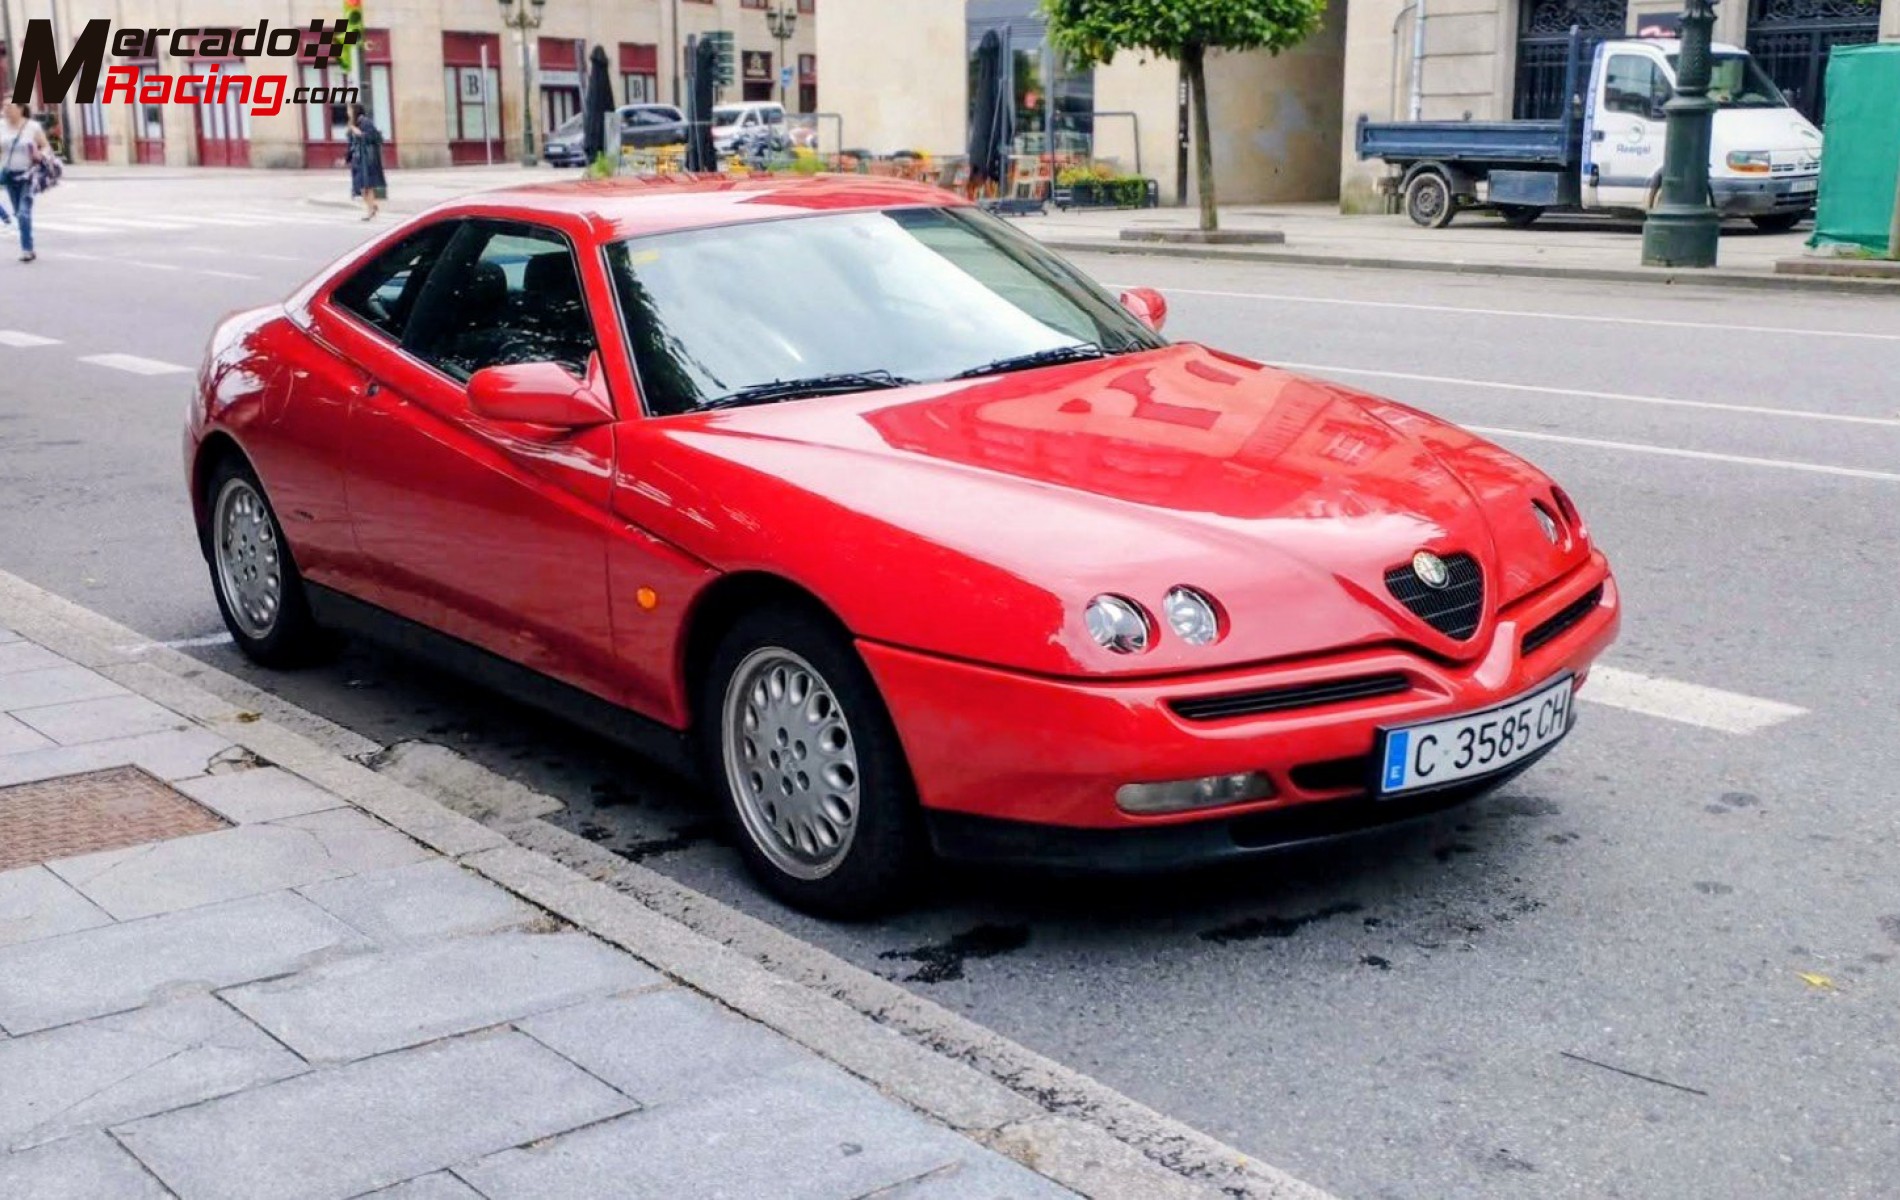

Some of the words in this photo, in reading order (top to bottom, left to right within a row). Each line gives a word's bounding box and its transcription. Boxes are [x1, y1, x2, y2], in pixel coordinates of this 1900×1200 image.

[466, 74, 479, 96] B
[632, 79, 642, 99] B
[1414, 734, 1438, 777] C
[1453, 708, 1533, 769] 3585
[1536, 689, 1568, 740] CH
[1389, 765, 1401, 779] E
